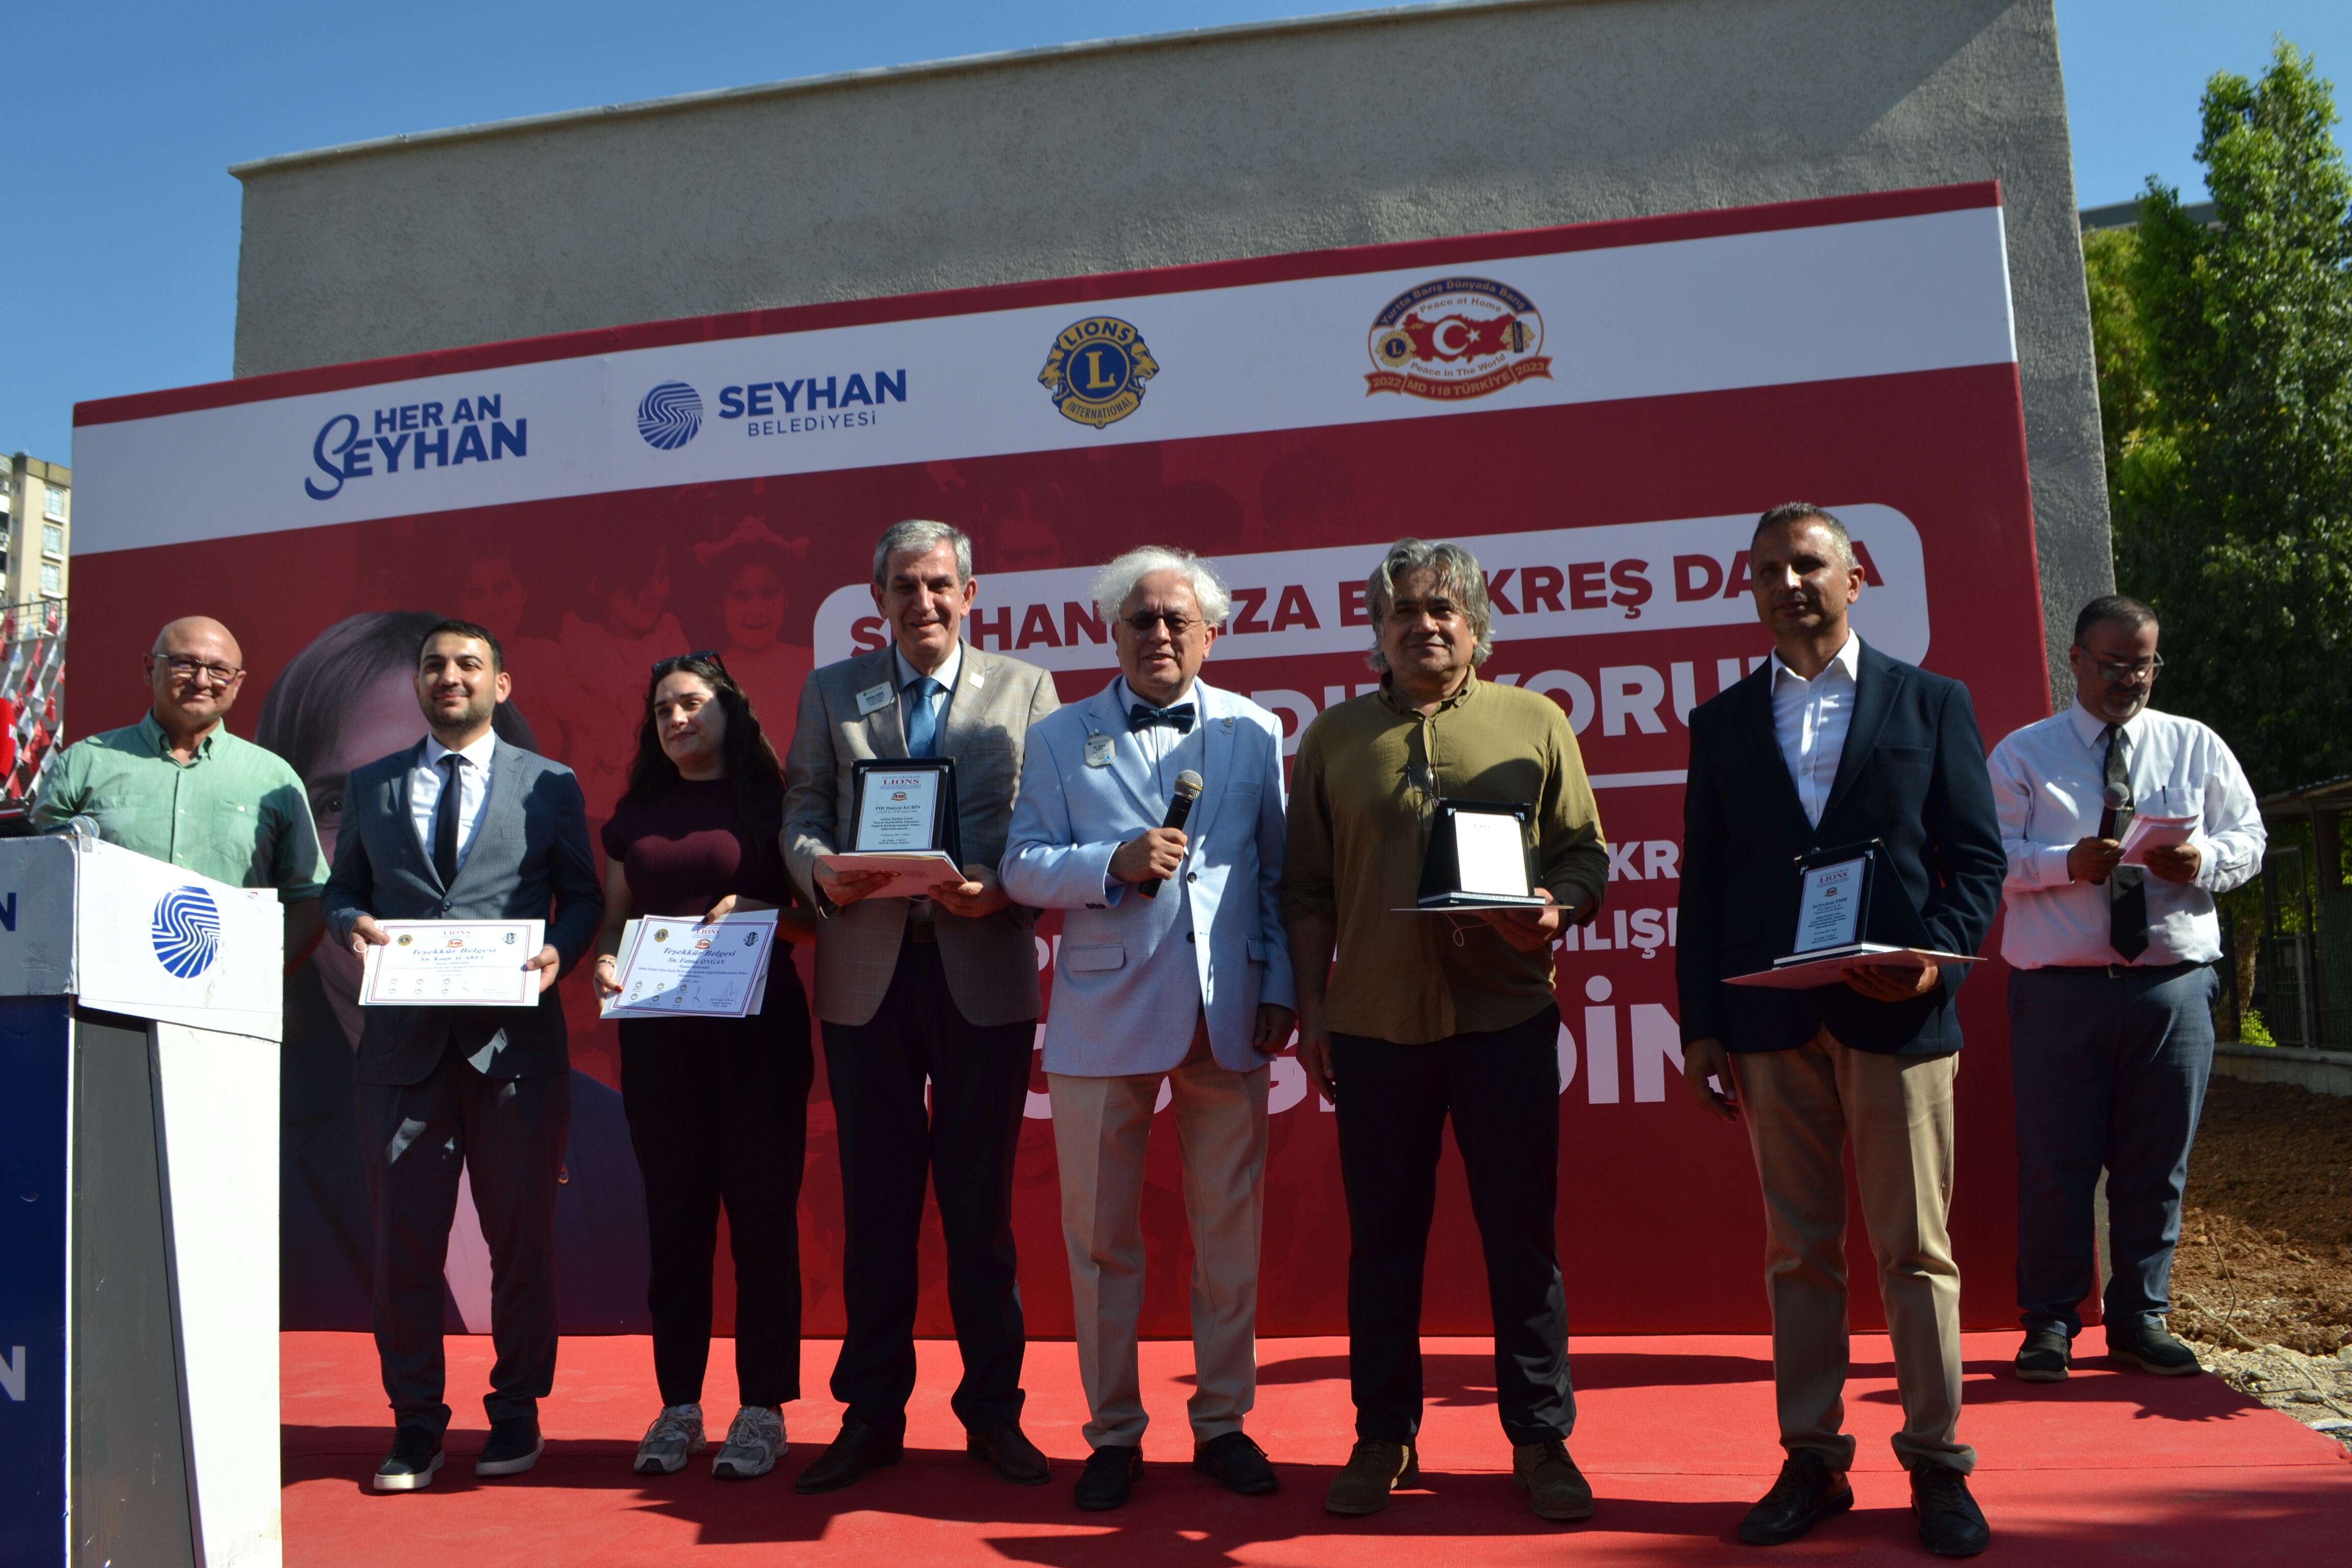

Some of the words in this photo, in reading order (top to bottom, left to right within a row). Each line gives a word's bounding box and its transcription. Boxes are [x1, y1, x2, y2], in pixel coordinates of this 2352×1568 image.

[1381, 297, 1411, 324] Yurtta
[1413, 284, 1443, 299] Barış
[1447, 279, 1496, 291] Dünyada
[1499, 287, 1526, 310] Barış
[1419, 299, 1453, 313] Peace
[1471, 297, 1502, 312] Home
[1063, 320, 1131, 347] LIONS
[1085, 351, 1116, 389] L
[1372, 376, 1402, 388] 2022
[1407, 380, 1427, 393] MD
[1430, 385, 1451, 396] 118
[1453, 371, 1511, 396] TÜRKİYE
[1515, 361, 1545, 376] 2023
[1410, 361, 1441, 376] Peace
[1444, 369, 1453, 377] in
[1456, 368, 1476, 376] The
[1477, 353, 1506, 372] World
[718, 369, 906, 419] SEYHAN
[1067, 397, 1133, 419] INTERNATIONAL
[374, 402, 444, 434] HER
[451, 394, 501, 424] AN
[305, 414, 527, 501] SEYHAN
[1482, 558, 1653, 620] KREŞ
[1820, 871, 1848, 884] LIONS
[664, 948, 703, 956] Teşekkür
